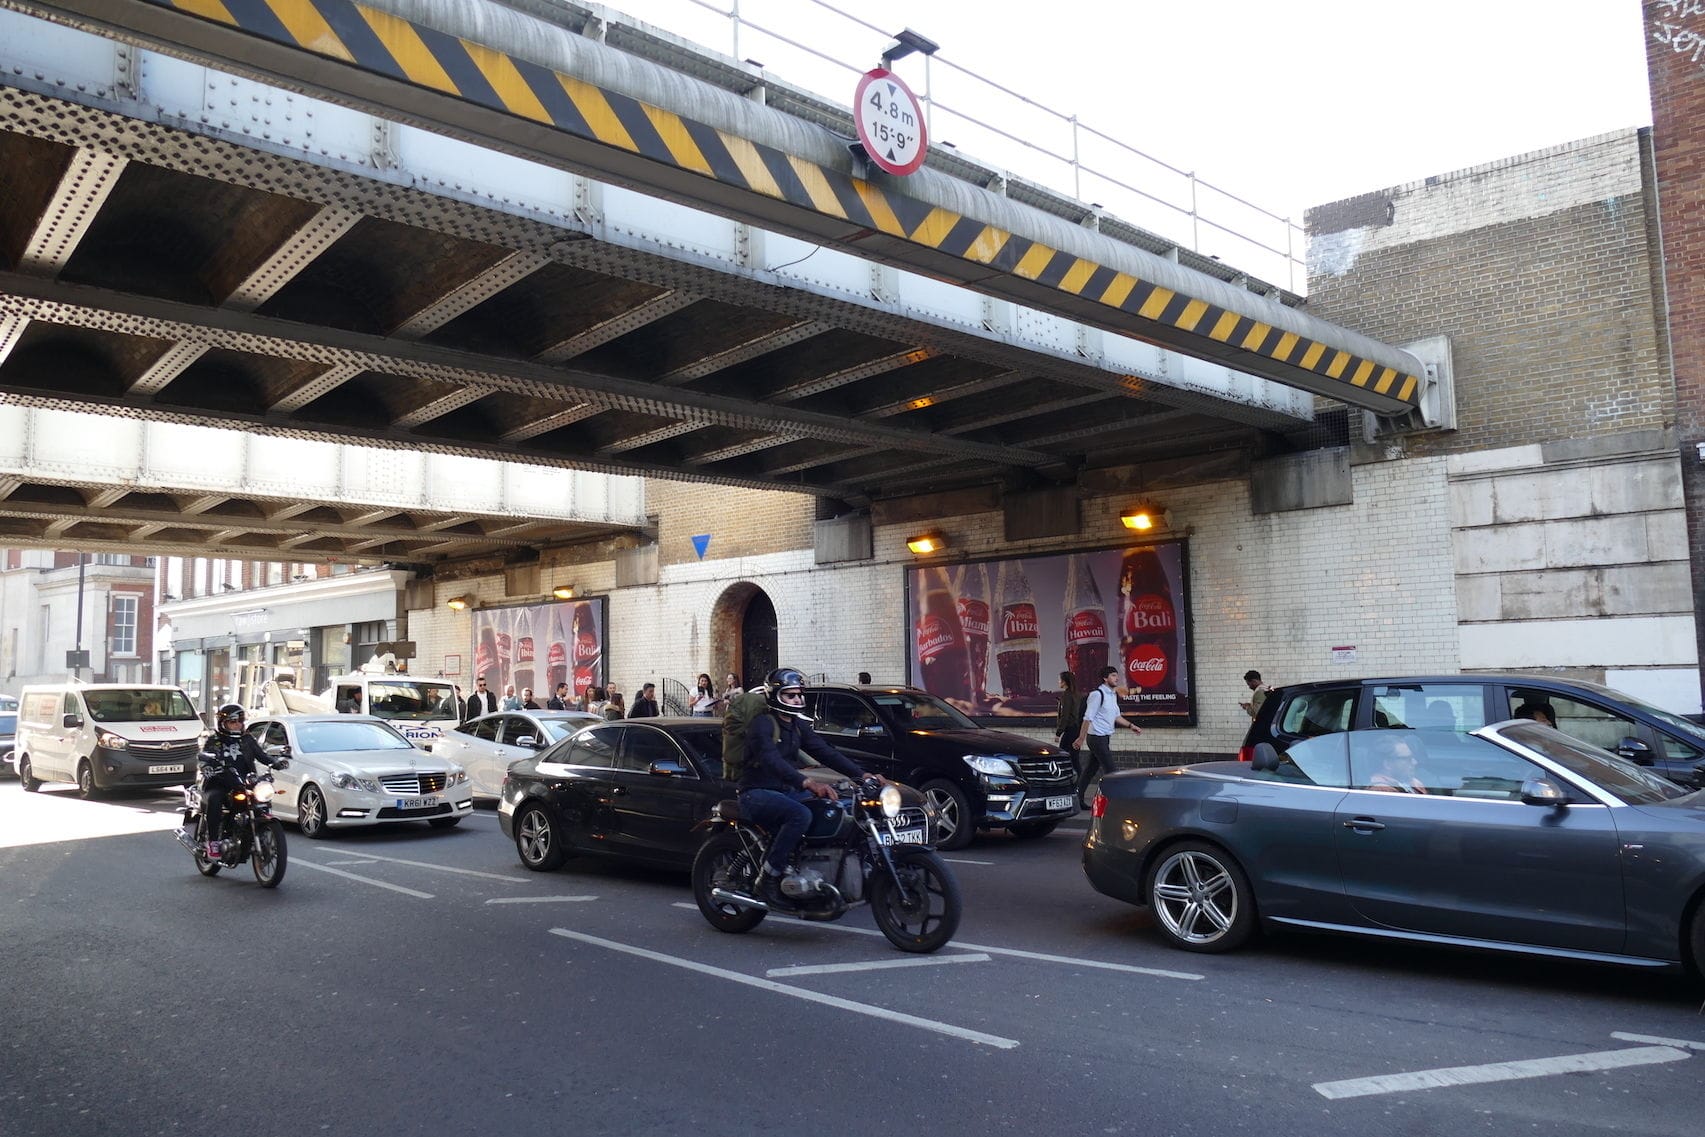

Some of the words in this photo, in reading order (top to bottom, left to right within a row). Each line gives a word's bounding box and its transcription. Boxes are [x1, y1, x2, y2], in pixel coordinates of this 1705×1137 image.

[1133, 611, 1171, 628] Bali
[1069, 627, 1104, 639] Hawaii
[1129, 658, 1165, 672] Coca-Cola
